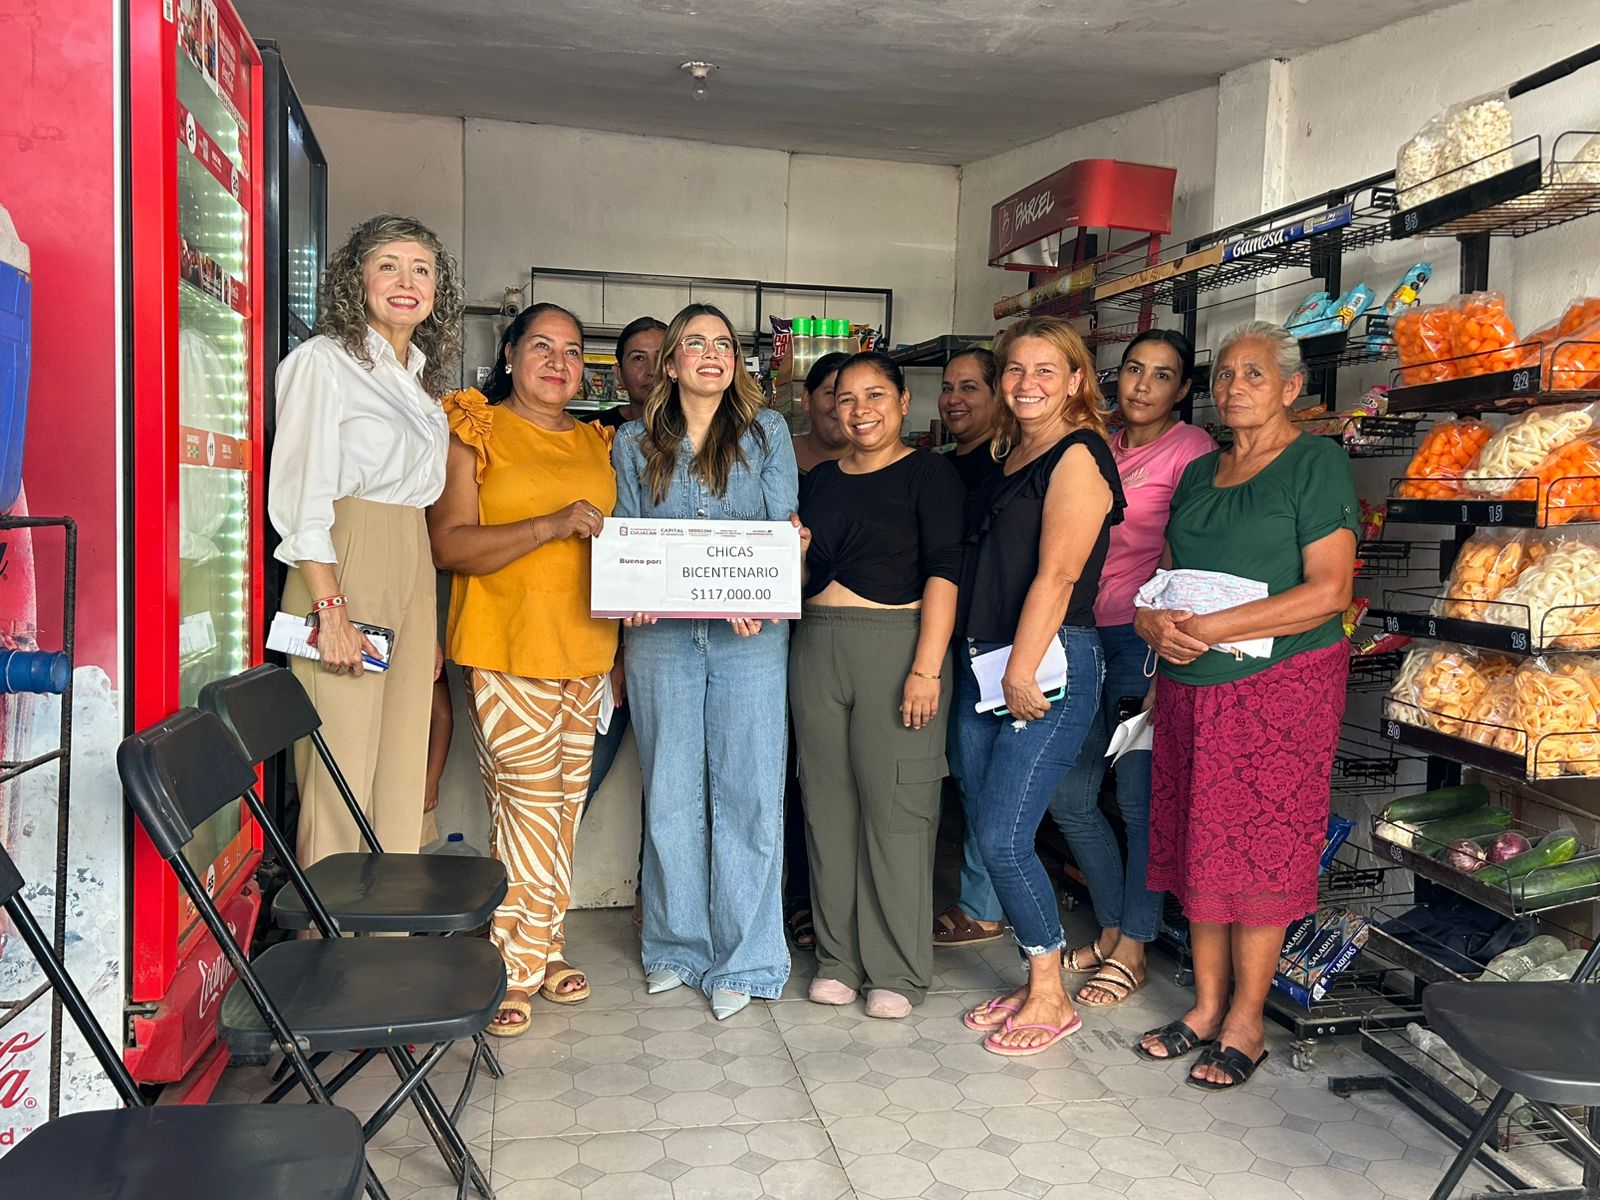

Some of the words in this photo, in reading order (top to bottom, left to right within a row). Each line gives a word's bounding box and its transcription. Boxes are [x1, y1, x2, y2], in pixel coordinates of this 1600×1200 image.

[1015, 190, 1055, 231] BARCEL
[1404, 211, 1418, 231] 55
[1232, 227, 1284, 258] Gamesa
[1512, 371, 1529, 391] 22
[1461, 505, 1468, 522] 1
[1488, 505, 1503, 523] 15
[706, 545, 754, 558] CHICAS
[646, 558, 662, 566] por:
[682, 566, 779, 578] BICENTENARIO
[690, 588, 772, 602] $117,000.00
[1387, 616, 1400, 632] 16
[1428, 620, 1437, 636] 2
[1510, 631, 1527, 650] 25
[1387, 721, 1401, 740] 20
[1282, 918, 1313, 954] SALADITAS
[1309, 929, 1341, 967] SALADITAS
[1327, 946, 1357, 979] LADITAS
